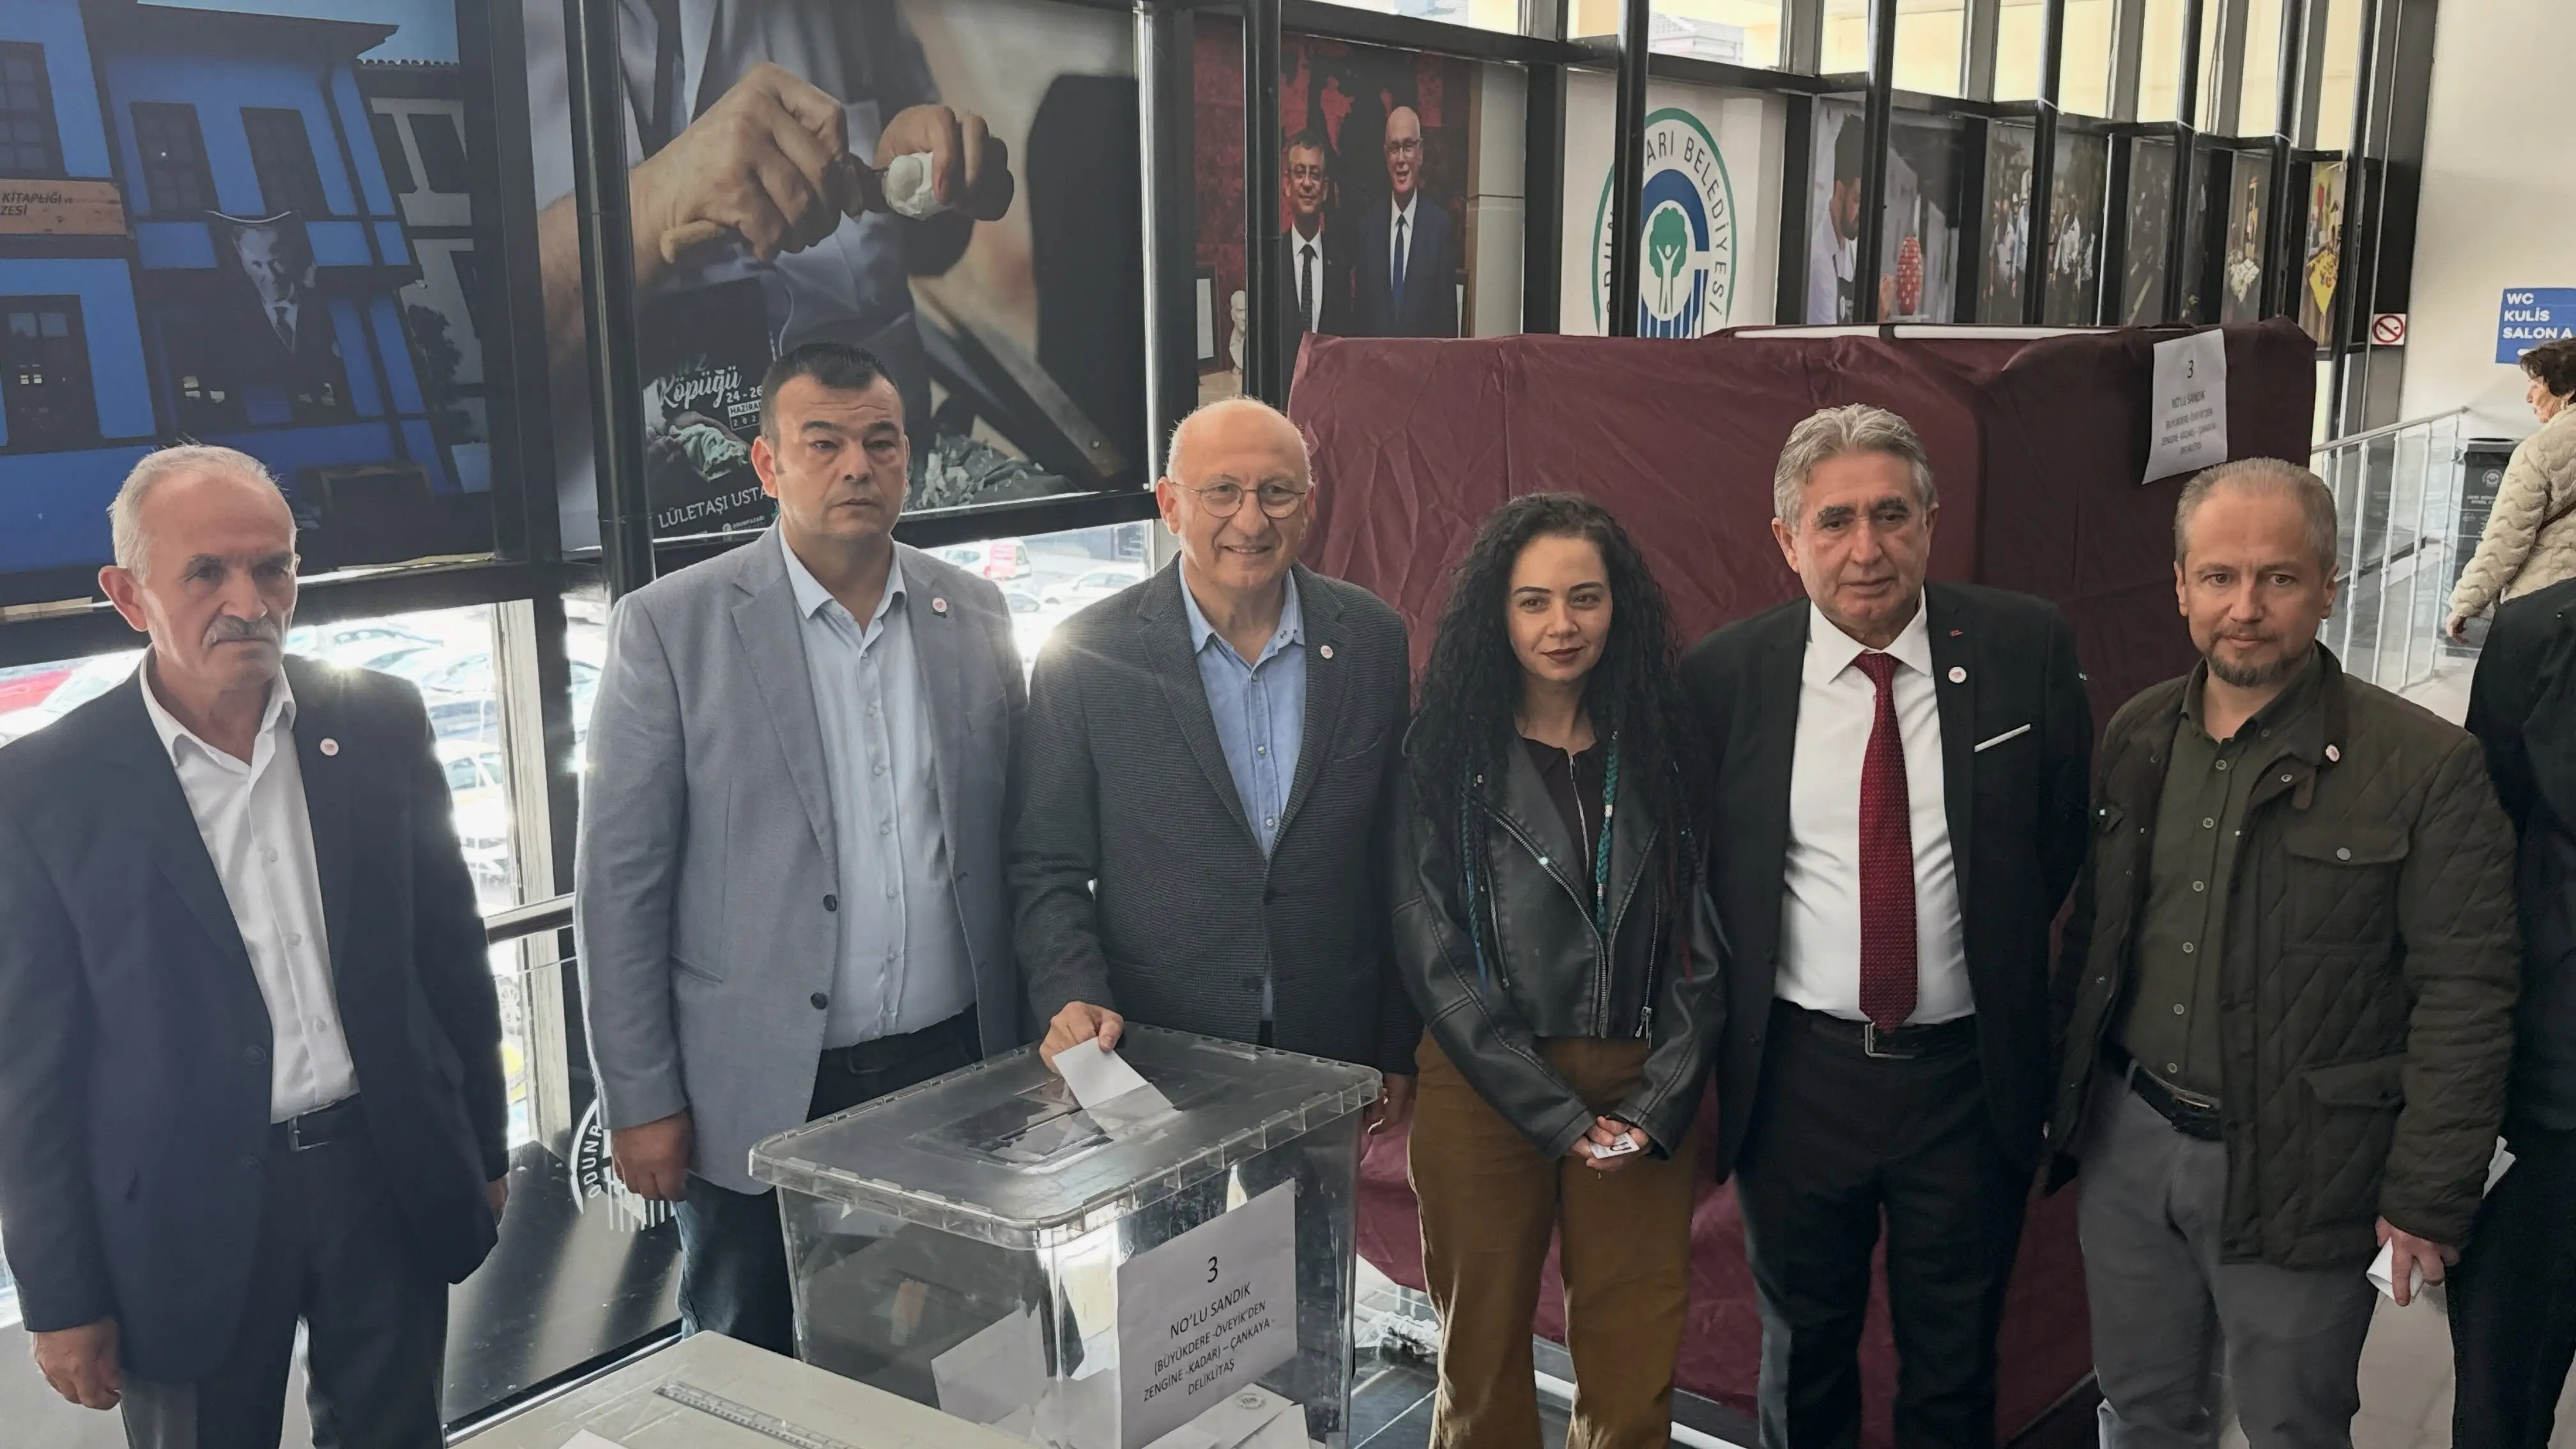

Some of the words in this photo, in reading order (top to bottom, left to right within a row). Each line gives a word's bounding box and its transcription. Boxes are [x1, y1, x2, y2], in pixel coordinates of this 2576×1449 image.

[1683, 137, 1729, 316] BELEDİYESİ
[2506, 293, 2534, 305] WC
[2504, 307, 2550, 322] KULİS
[2502, 326, 2558, 339] SALON
[2560, 326, 2573, 339] A
[2187, 360, 2193, 378] 3
[657, 365, 742, 410] Köpüğü
[726, 390, 740, 403] 24
[749, 385, 763, 399] 26
[730, 401, 762, 415] HAZİRA
[658, 495, 729, 528] LÜLETAŞI
[1207, 1256, 1218, 1283] 3
[1211, 1282, 1251, 1317] SANDIK
[1230, 1318, 1270, 1351] ÇANKAYA
